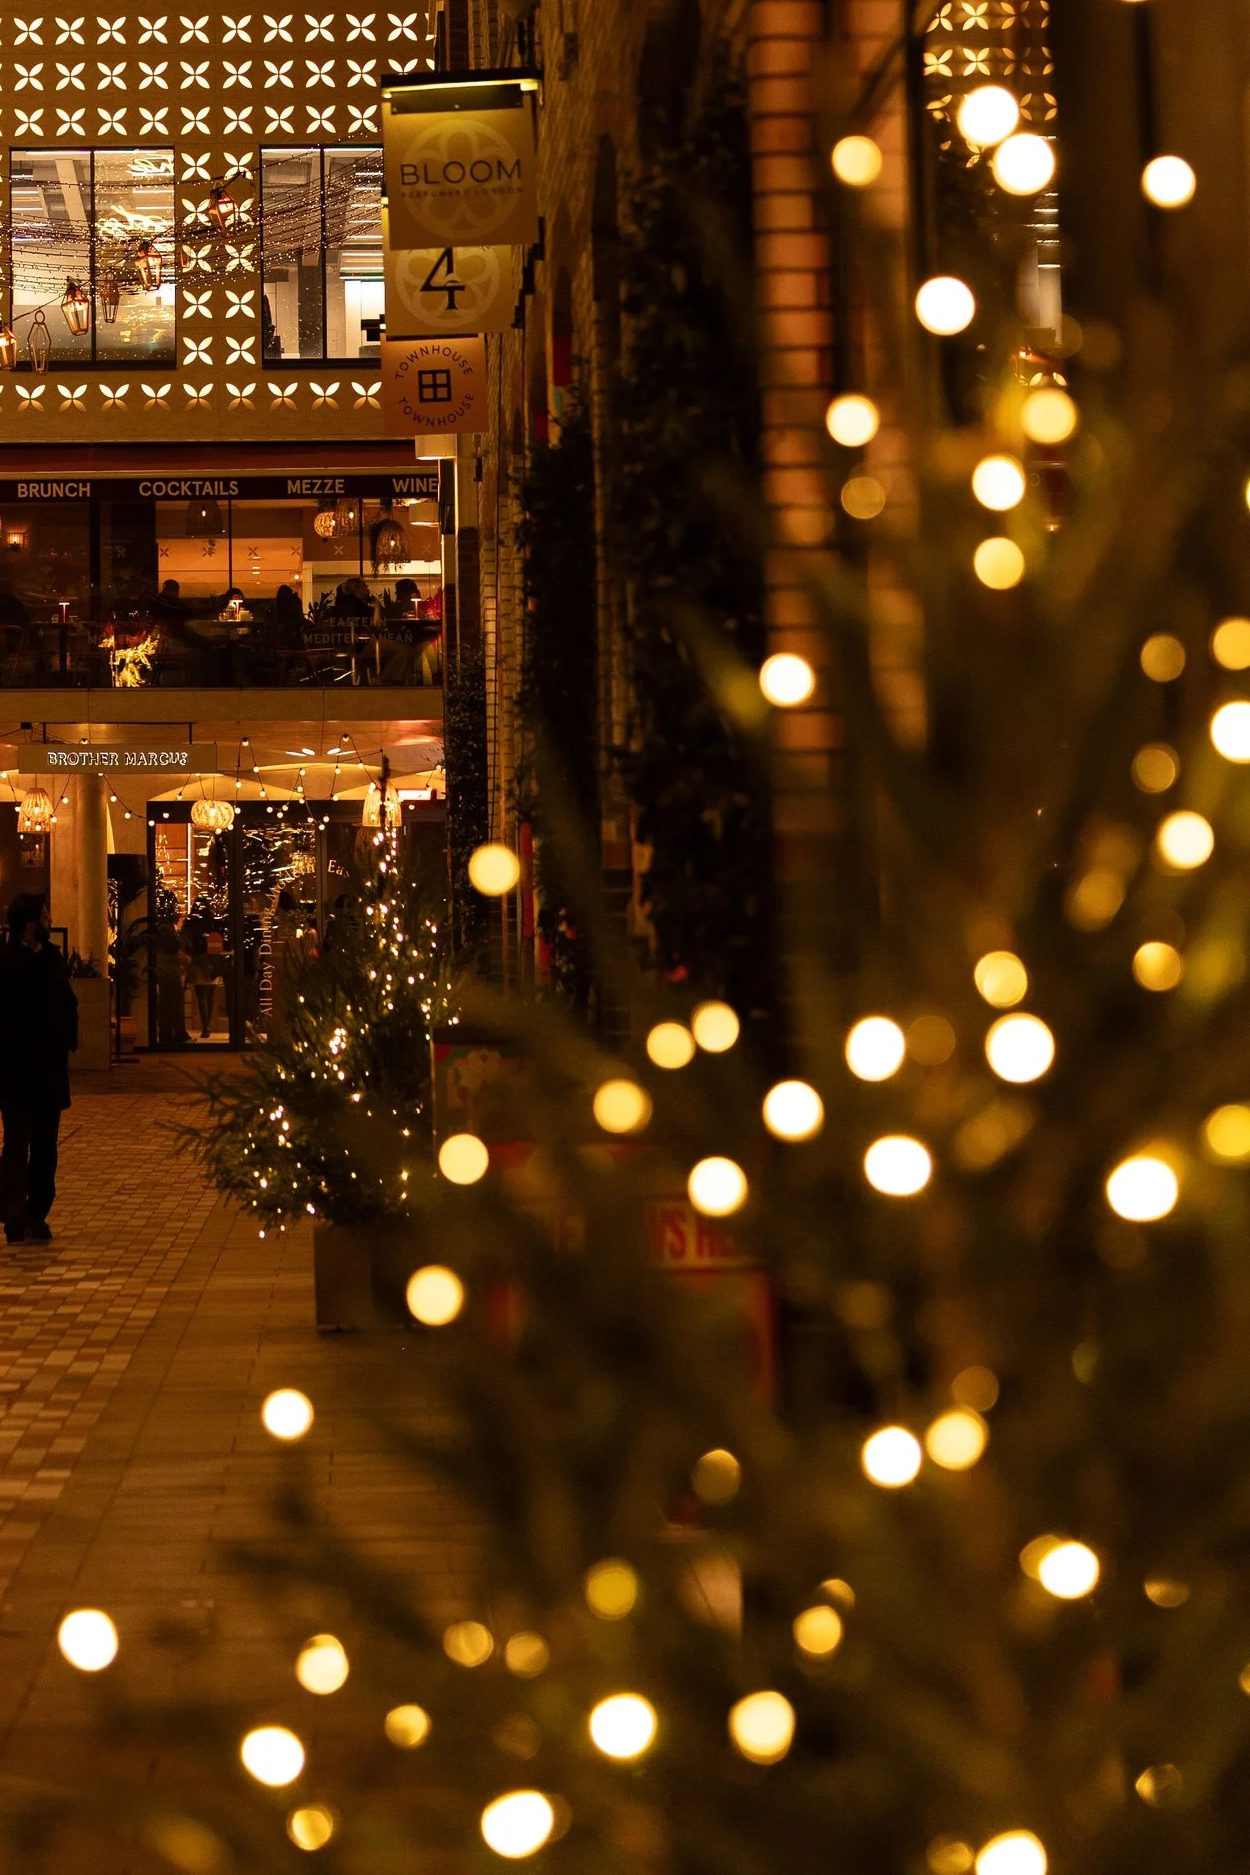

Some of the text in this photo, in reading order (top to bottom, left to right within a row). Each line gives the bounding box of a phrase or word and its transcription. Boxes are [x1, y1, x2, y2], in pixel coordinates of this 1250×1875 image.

[401, 159, 522, 185] BLOOM
[420, 247, 466, 310] 4
[395, 345, 473, 380] TOWNHOUSE
[398, 393, 474, 427] TOWNHOUSE
[17, 482, 91, 498] BRUNCH
[138, 480, 239, 496] COCKTAILS
[287, 479, 345, 495] MEZZE
[392, 478, 438, 493] WINE
[329, 616, 387, 627] EASTERN
[47, 752, 189, 766] BROTHER MARCUS
[259, 961, 275, 991] Day
[260, 996, 273, 1017] All
